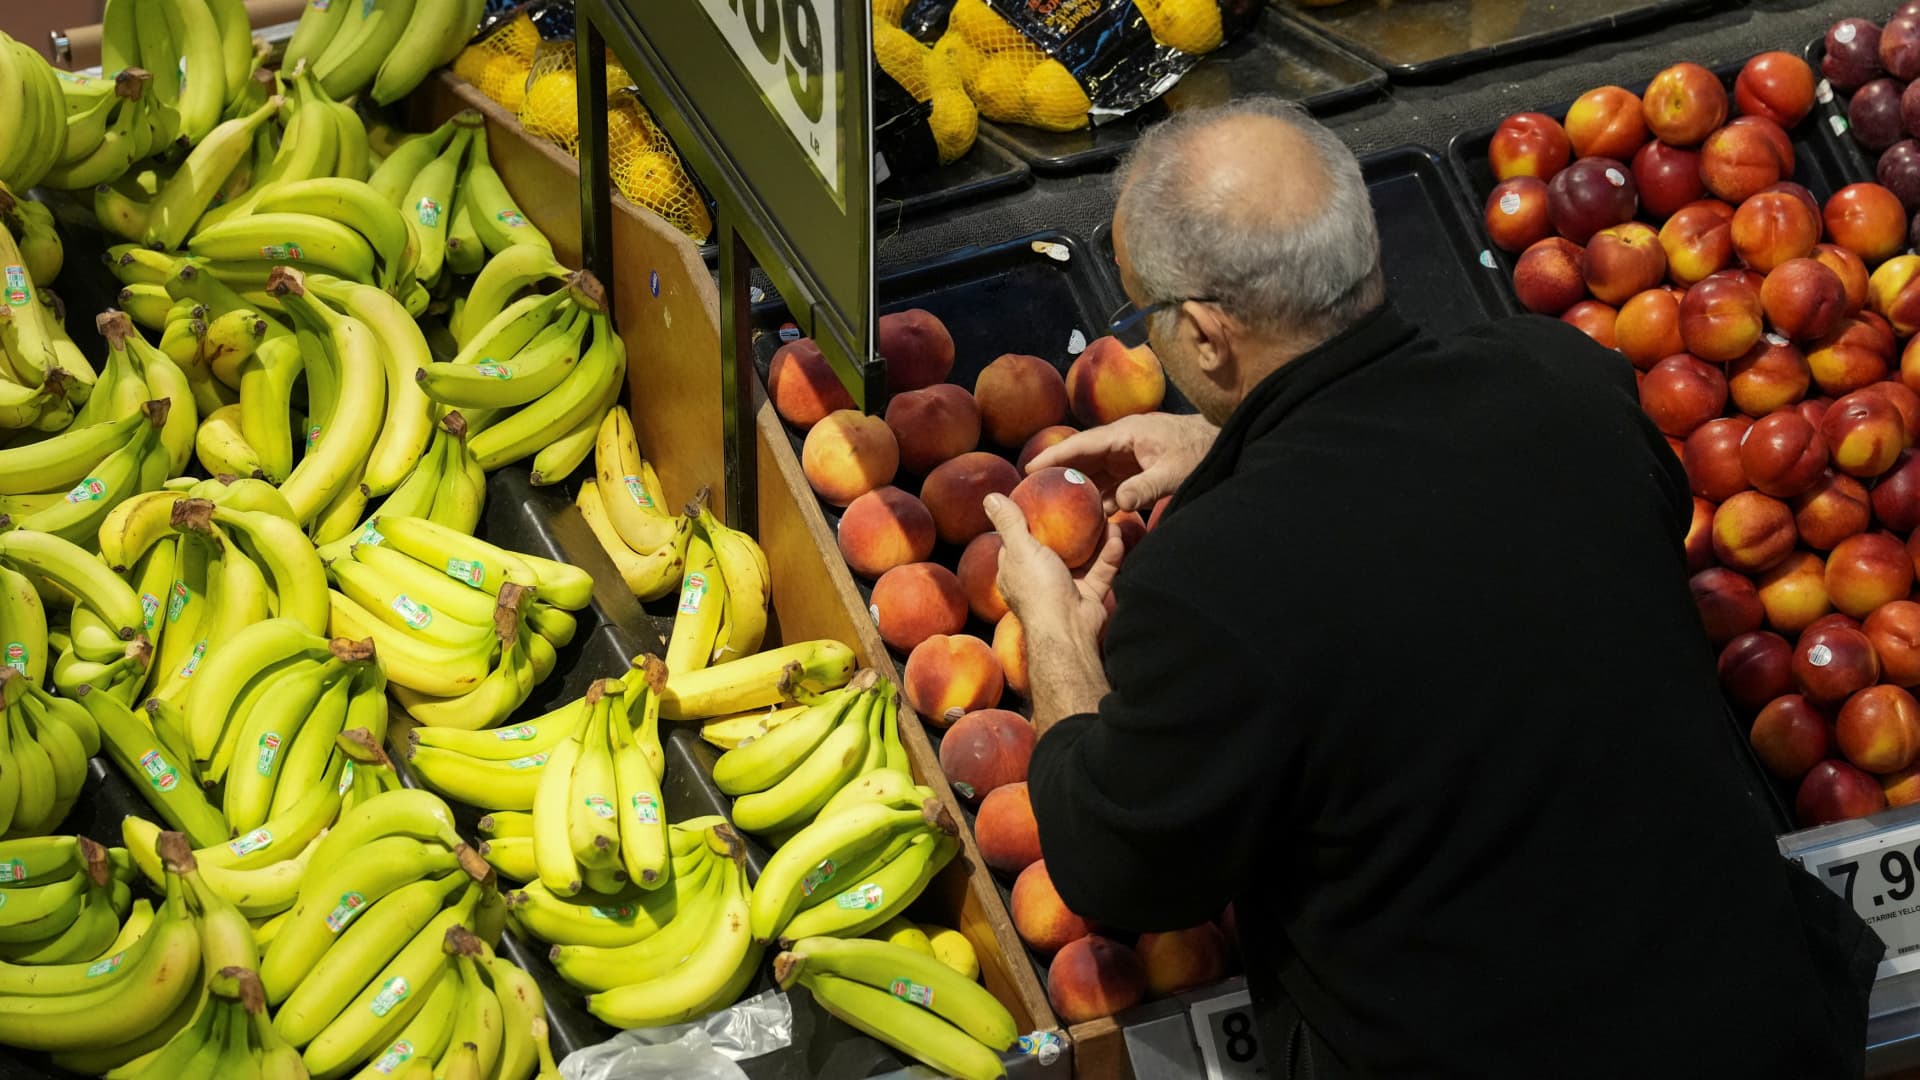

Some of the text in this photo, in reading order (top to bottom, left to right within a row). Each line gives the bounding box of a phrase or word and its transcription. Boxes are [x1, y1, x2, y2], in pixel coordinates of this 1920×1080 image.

[809, 131, 820, 157] LB
[1864, 911, 1897, 925] CTARINE
[1222, 1012, 1258, 1063] 8
